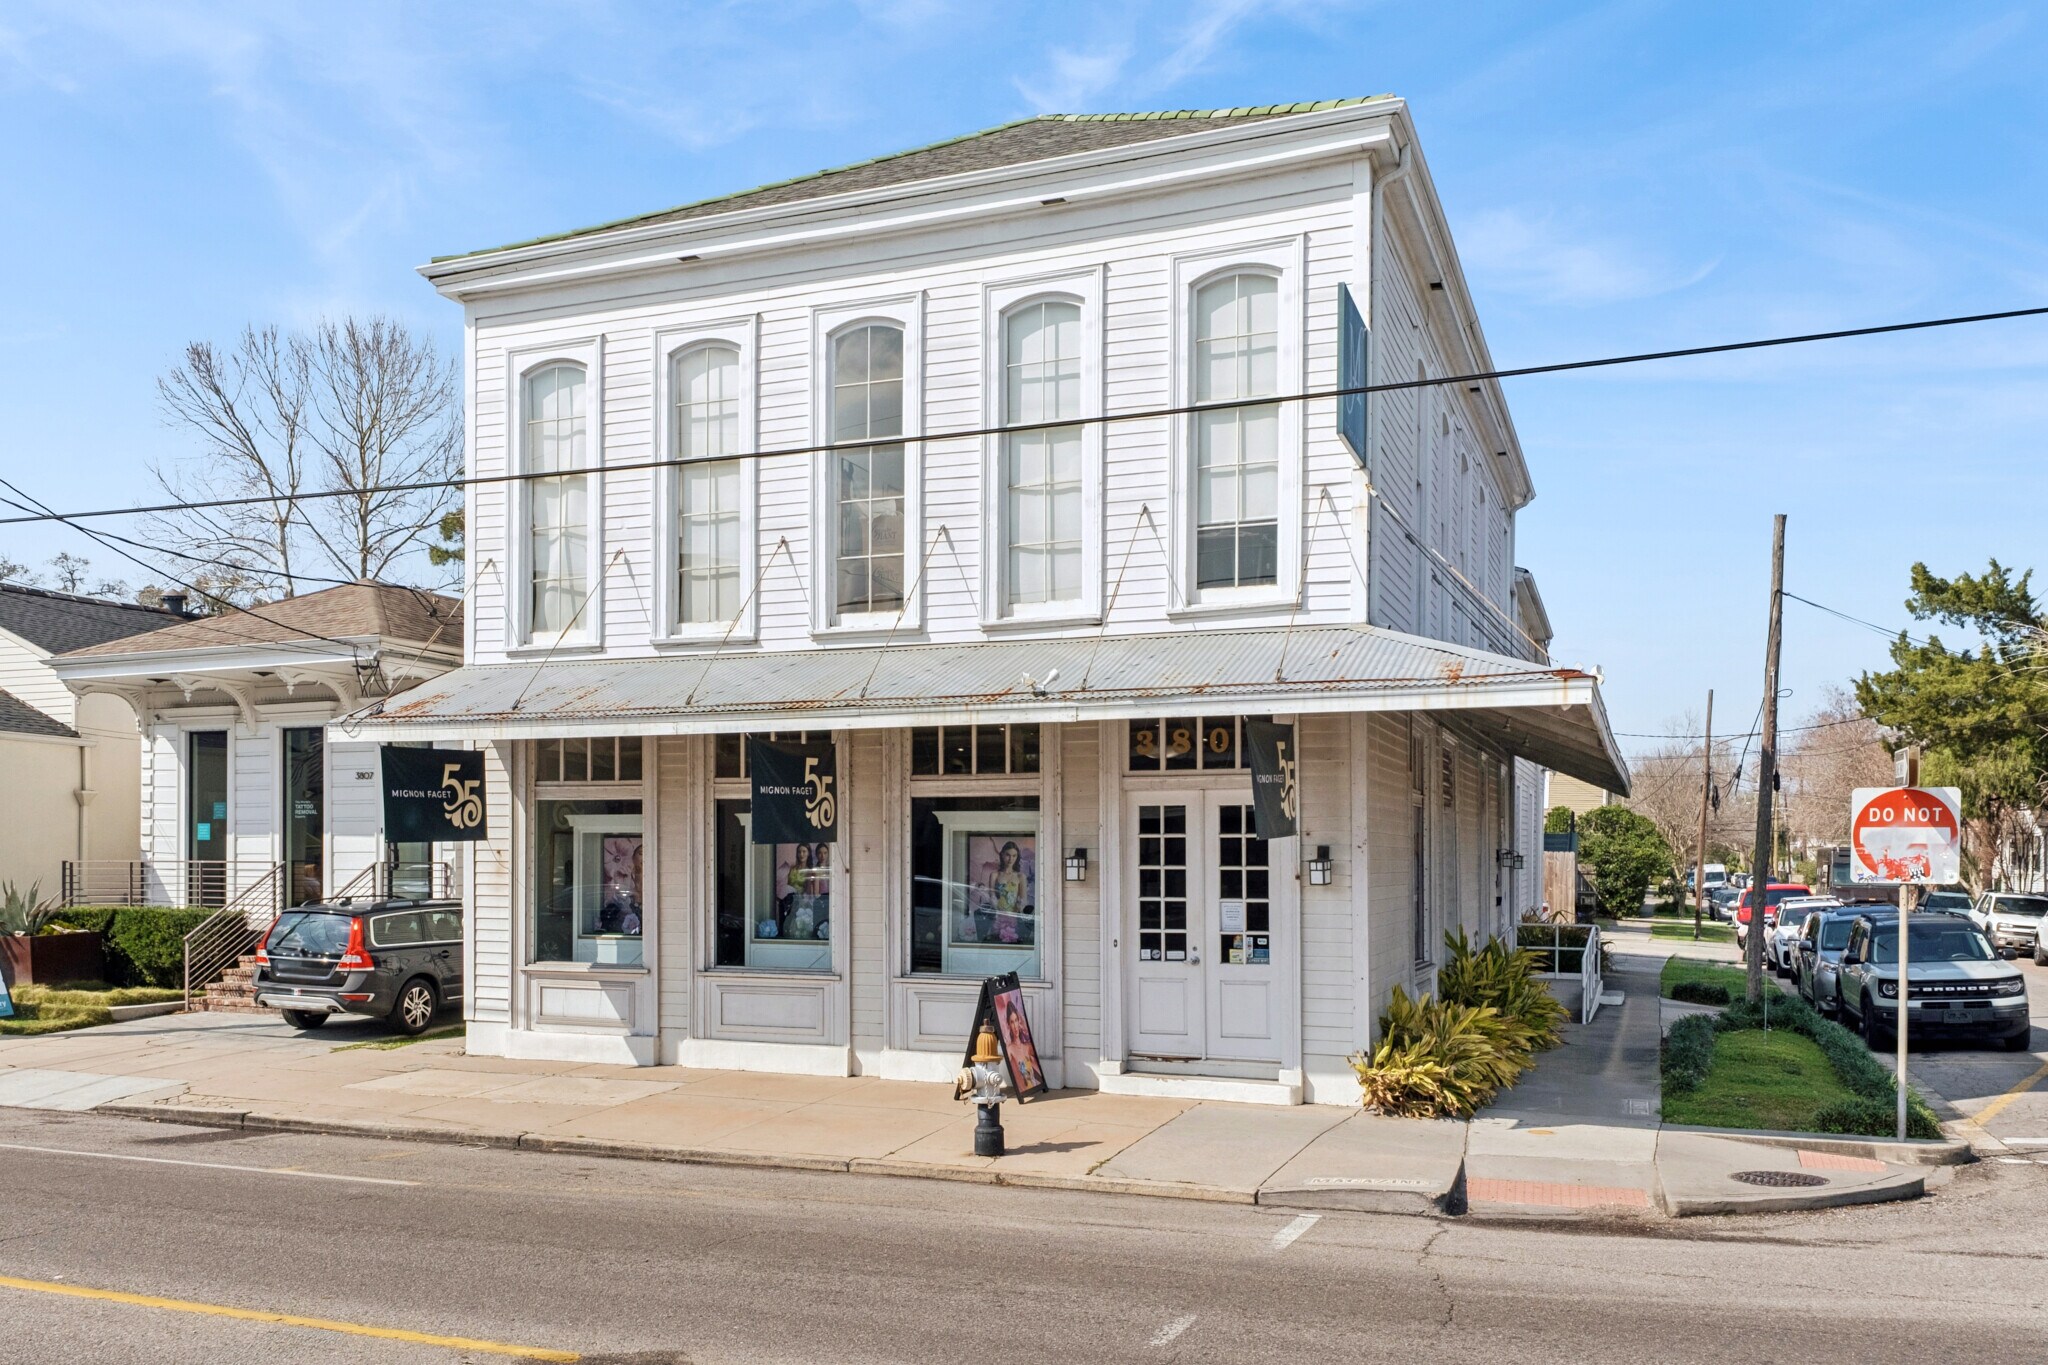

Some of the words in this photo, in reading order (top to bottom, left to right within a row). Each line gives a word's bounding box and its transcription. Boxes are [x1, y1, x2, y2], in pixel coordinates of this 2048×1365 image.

[355, 771, 374, 780] 3807
[1273, 774, 1284, 783] FAGET
[391, 789, 425, 798] MIGNON
[427, 790, 452, 799] FAGET
[760, 785, 790, 795] MIGNON
[792, 786, 813, 795] FAGET
[1869, 807, 1895, 822] DO
[1903, 807, 1943, 822] NOT
